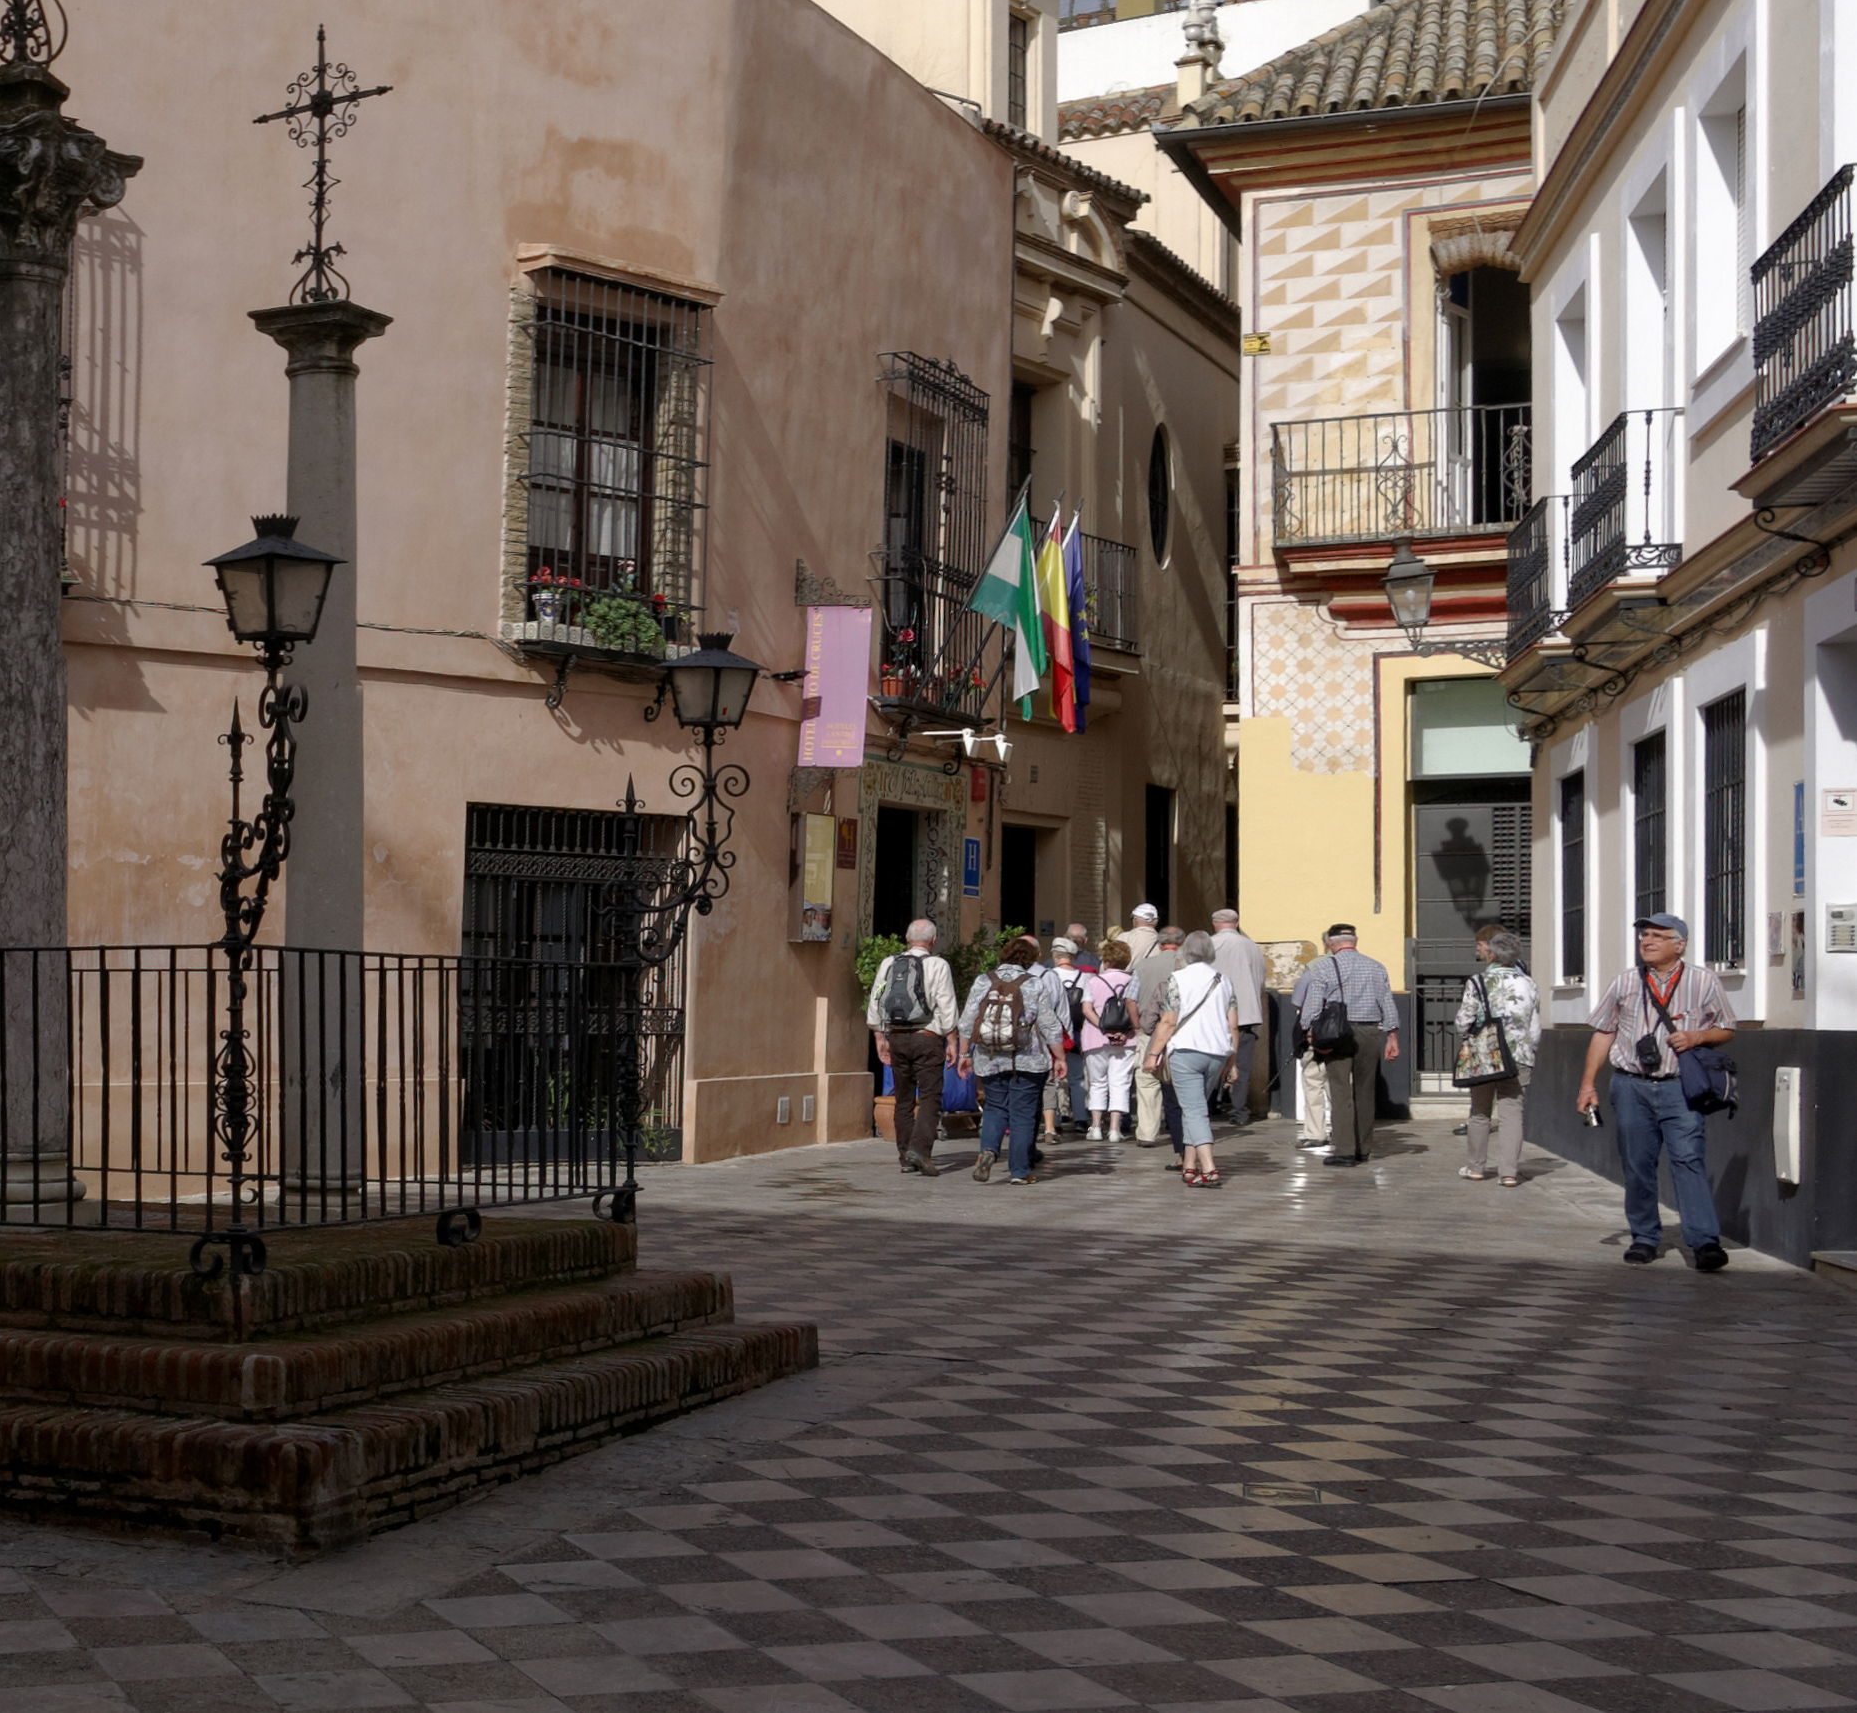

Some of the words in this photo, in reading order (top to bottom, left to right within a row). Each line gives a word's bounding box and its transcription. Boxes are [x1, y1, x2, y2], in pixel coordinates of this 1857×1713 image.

[811, 613, 823, 660] CRUCES
[809, 663, 820, 679] DE
[807, 682, 820, 718] PATIO
[803, 720, 816, 762] HOTEL
[967, 843, 977, 871] H
